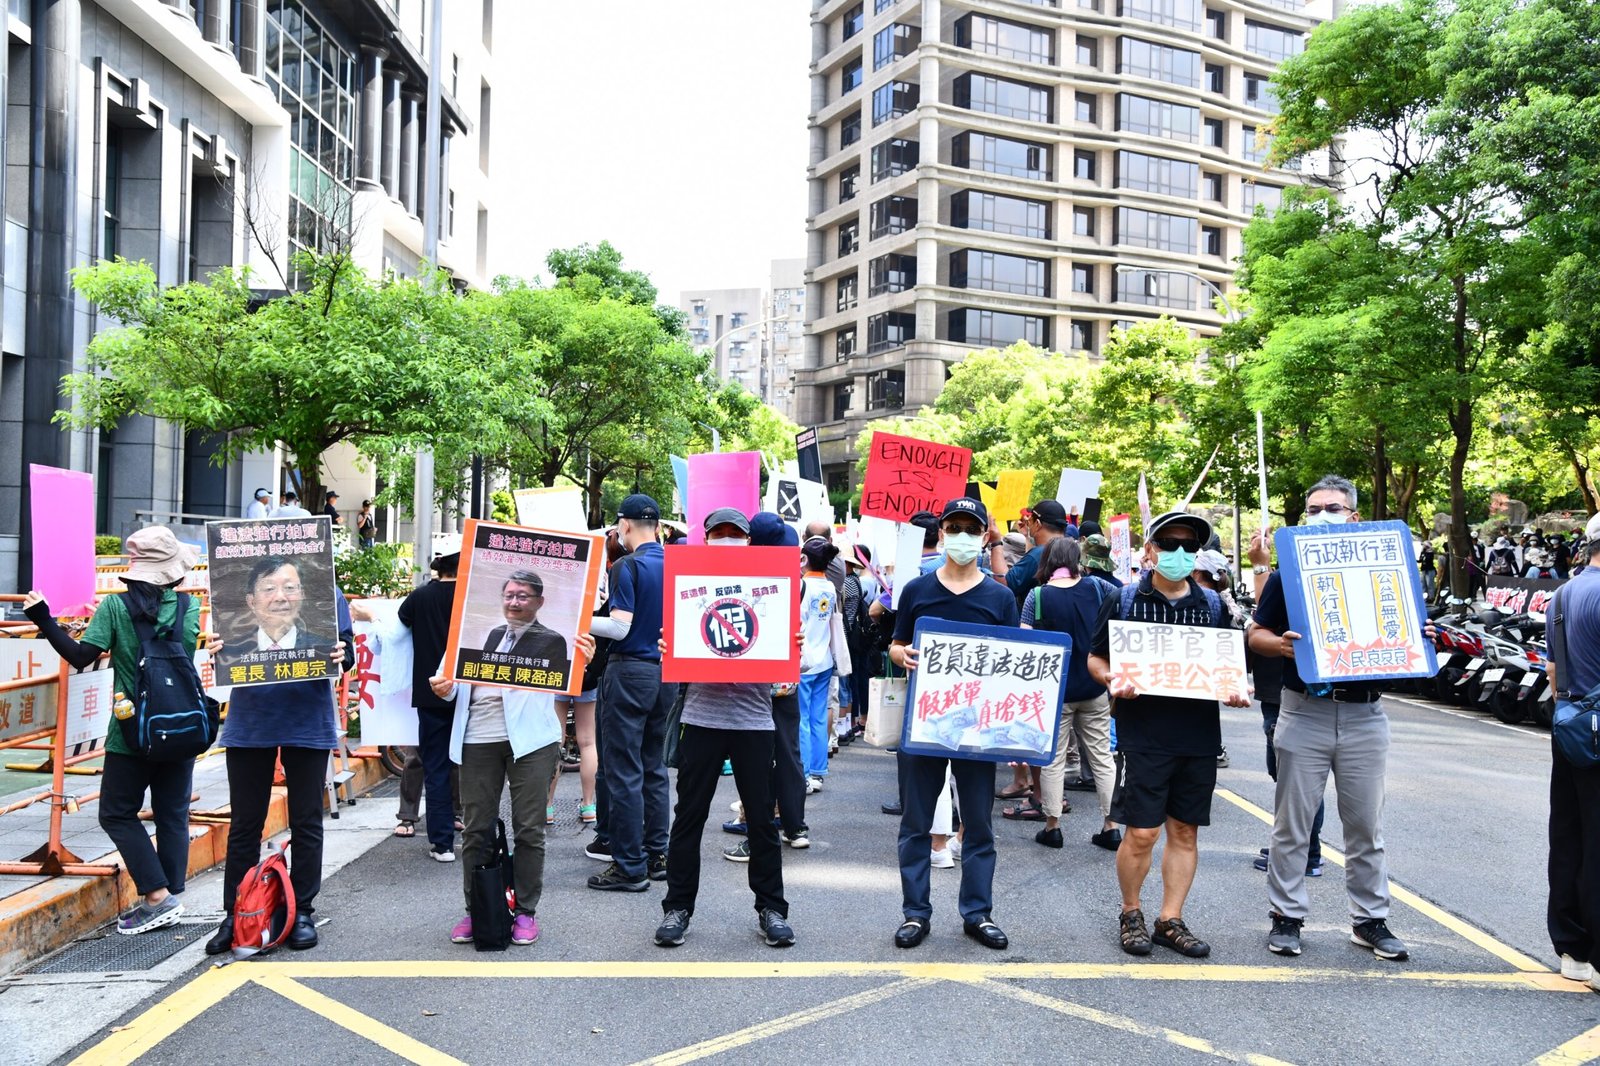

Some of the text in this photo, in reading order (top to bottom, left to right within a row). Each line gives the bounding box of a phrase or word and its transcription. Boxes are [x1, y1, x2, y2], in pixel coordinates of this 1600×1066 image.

[881, 441, 963, 476] ENOUGH
[888, 469, 934, 492] IS
[866, 491, 942, 517] ENOUG
[221, 523, 318, 543] 違法強行拍賣
[488, 532, 578, 559] 違法強行拍賣
[1302, 537, 1398, 566] 行政執行署
[240, 648, 316, 663] 法務部行政執行署
[1111, 624, 1238, 663] 犯罪官員
[230, 660, 327, 683] 署長 林慶宗
[481, 652, 550, 668] 法務部行政執行署
[923, 639, 1061, 683] 官員違法造假
[462, 661, 563, 687] 副署長 陳盈錦
